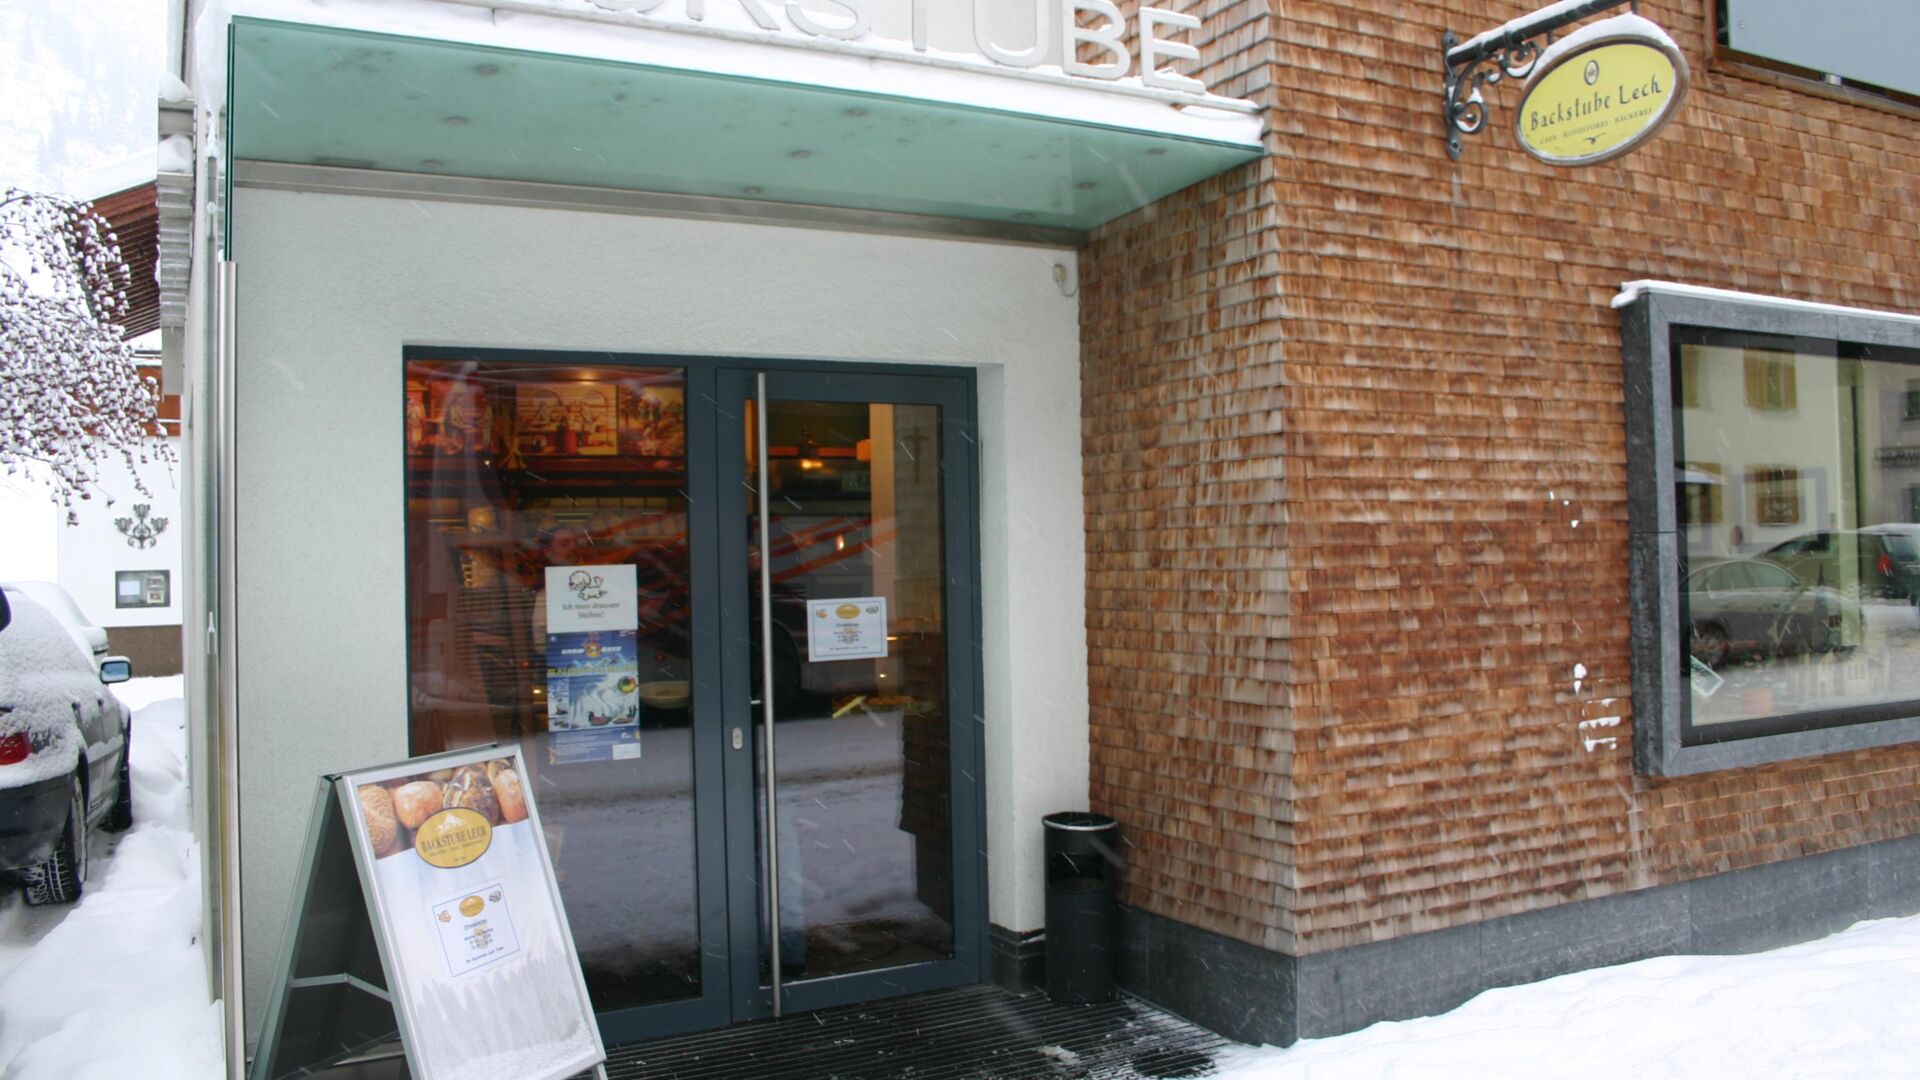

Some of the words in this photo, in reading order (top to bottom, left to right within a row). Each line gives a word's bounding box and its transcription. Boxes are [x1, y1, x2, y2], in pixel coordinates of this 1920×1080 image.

[1530, 91, 1611, 131] Backstube
[1618, 74, 1662, 105] Lech
[421, 830, 466, 853] BACKSTUBE
